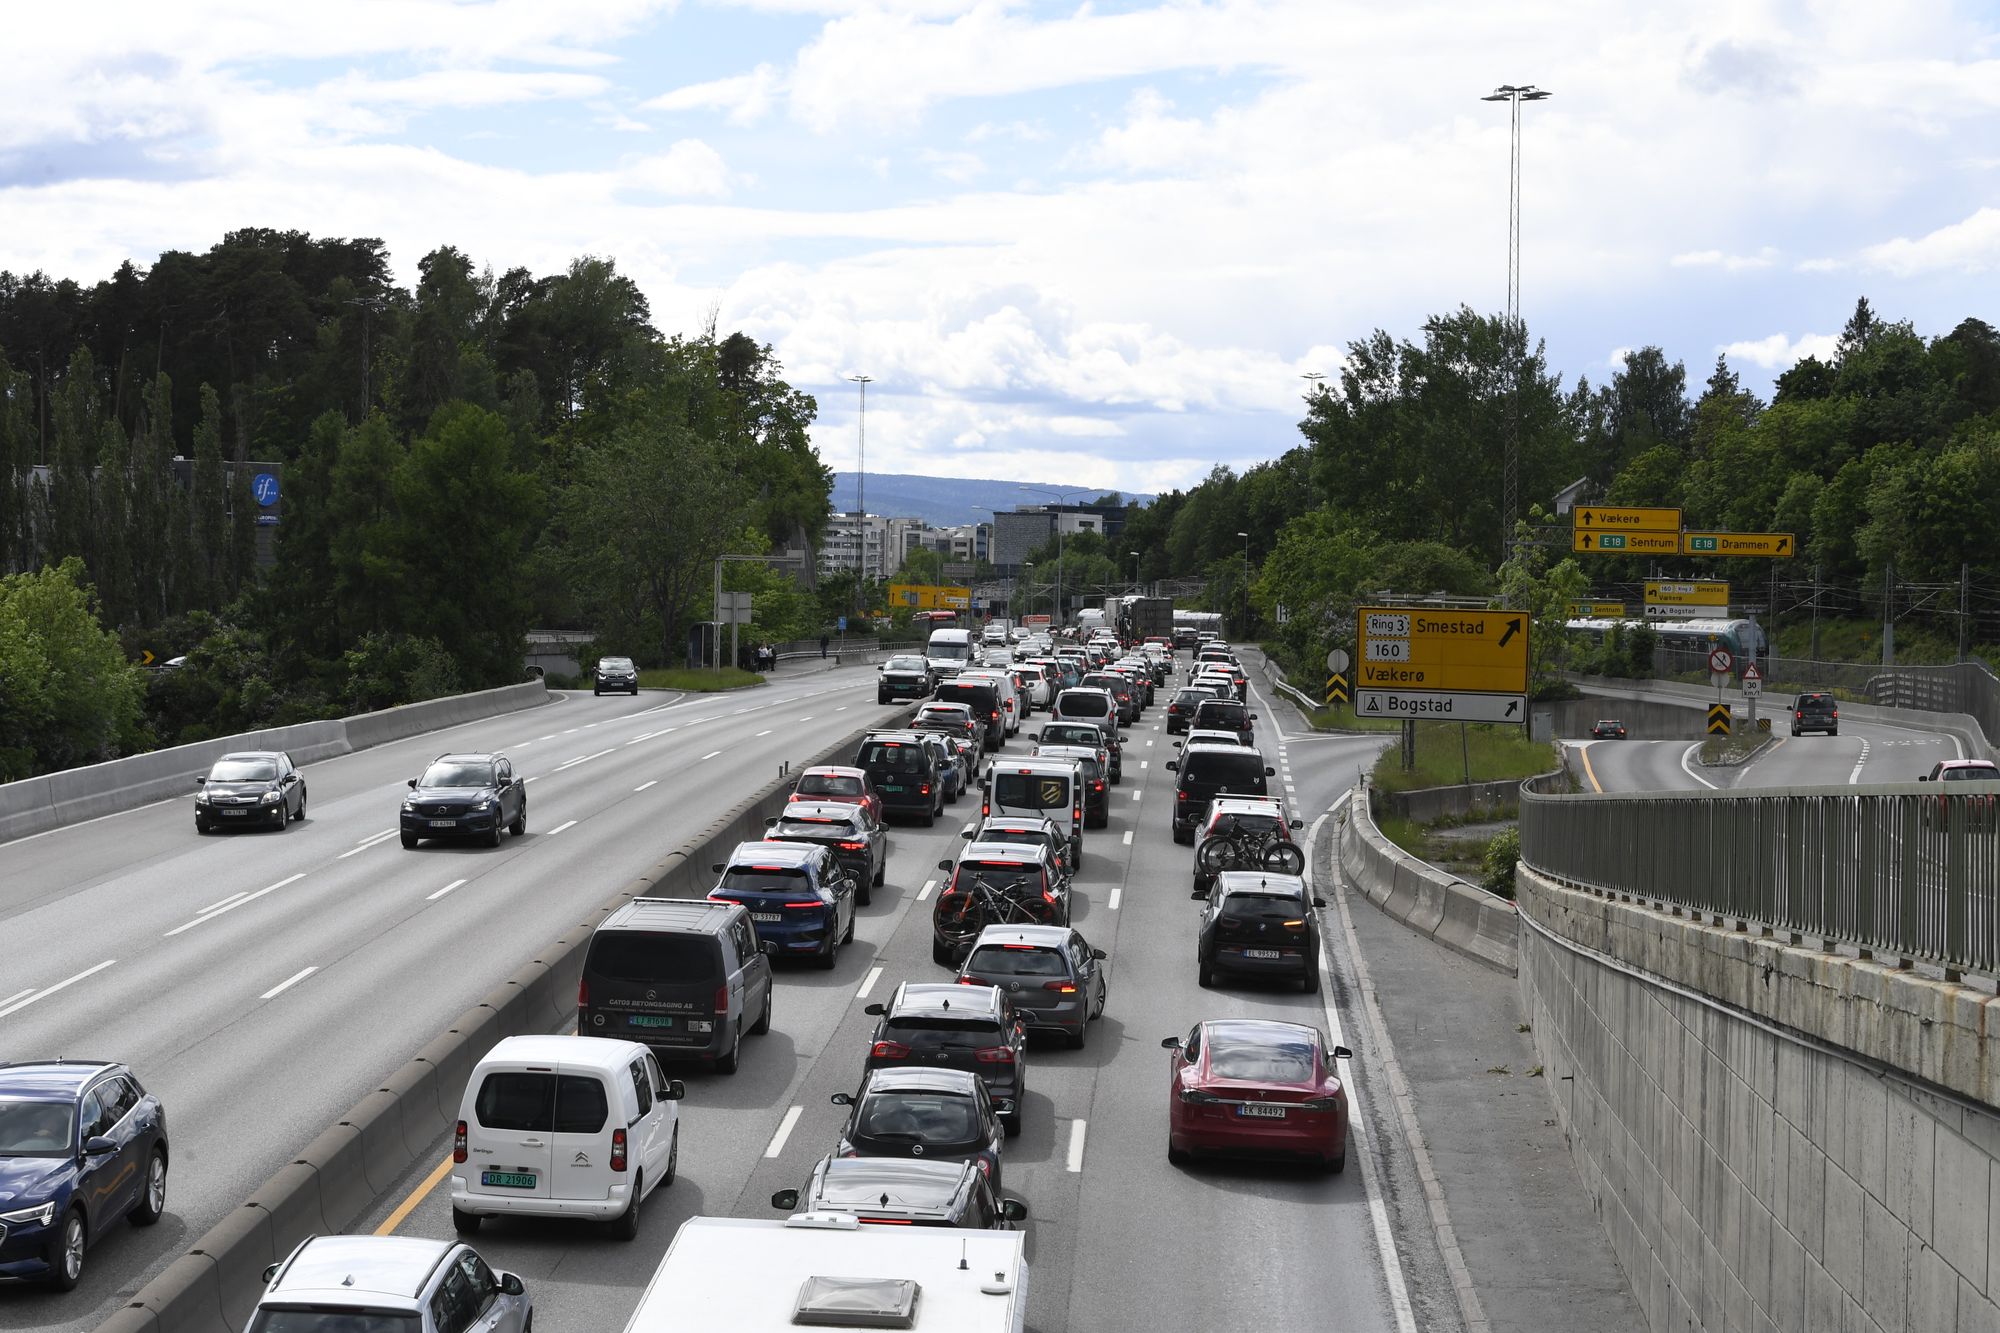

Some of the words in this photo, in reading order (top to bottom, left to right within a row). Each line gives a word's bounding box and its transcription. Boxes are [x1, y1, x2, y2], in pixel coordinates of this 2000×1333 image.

[1600, 513, 1640, 524] Vækerø
[1630, 537, 1674, 548] Sentrum
[1722, 540, 1769, 550] Drammen
[1696, 585, 1724, 593] Smestad
[1371, 619, 1394, 632] Ring
[1396, 619, 1405, 632] 3
[1416, 618, 1484, 634] Smestad
[1375, 644, 1400, 657] 160
[1366, 666, 1425, 682] Vækerø
[1388, 696, 1453, 714] Bogstad
[1242, 1104, 1254, 1116] EK
[1257, 1105, 1284, 1118] 84492
[489, 1175, 502, 1184] DR
[506, 1176, 533, 1186] 21906
